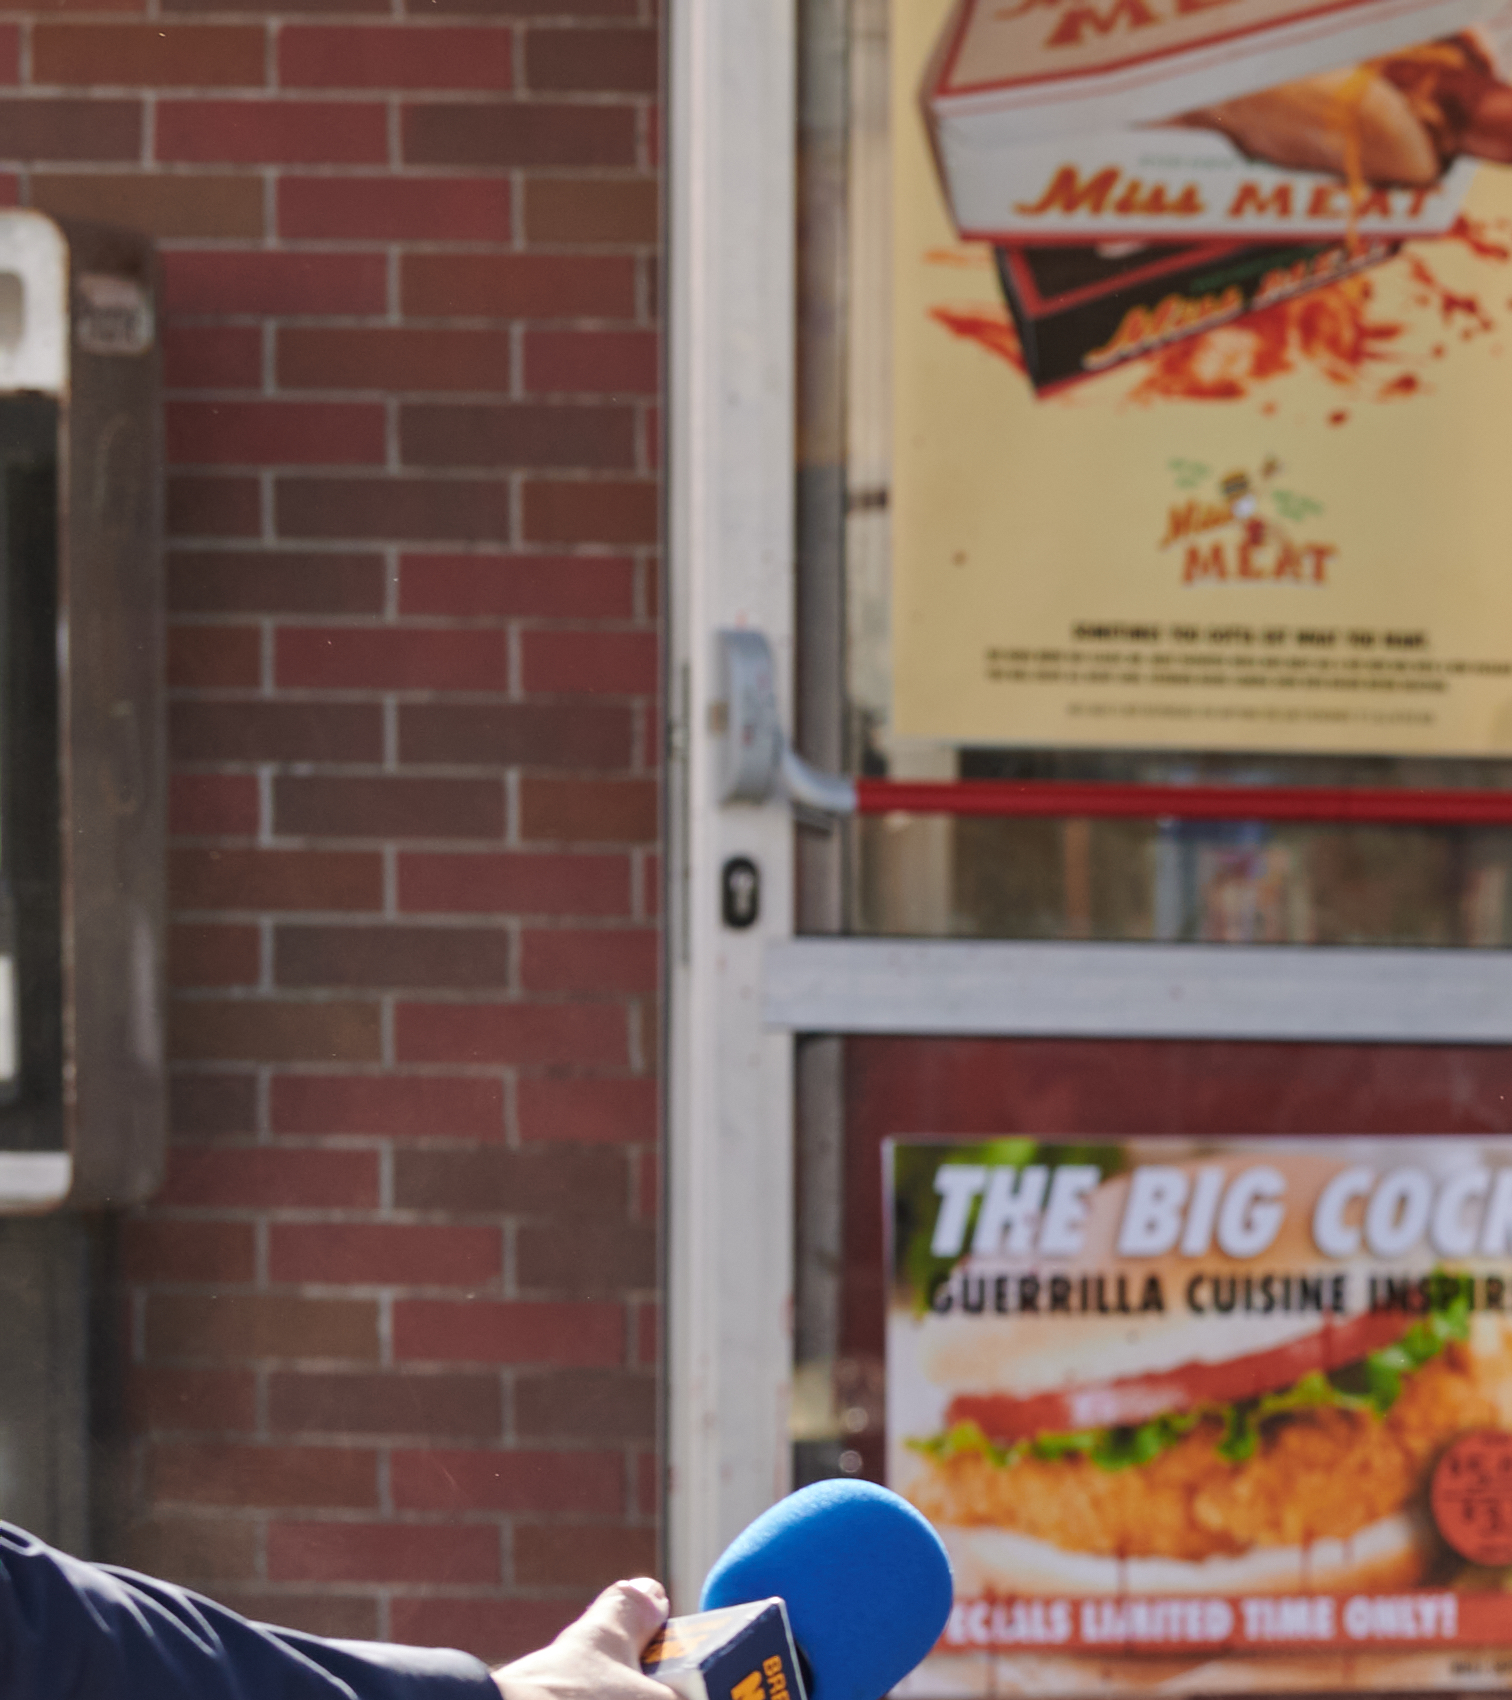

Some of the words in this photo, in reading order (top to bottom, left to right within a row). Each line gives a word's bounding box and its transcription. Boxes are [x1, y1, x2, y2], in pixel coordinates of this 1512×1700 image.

[1181, 540, 1339, 586] MEAT
[929, 1163, 1102, 1259] THE
[1117, 1163, 1288, 1259] BIG
[925, 1271, 1166, 1316] GUERRILLA
[1184, 1272, 1348, 1315] CUISINE
[947, 1598, 1070, 1647] ECIALS
[1079, 1596, 1235, 1645] LIMITED
[1240, 1595, 1336, 1642] TIME
[1342, 1592, 1458, 1642] ONLY!
